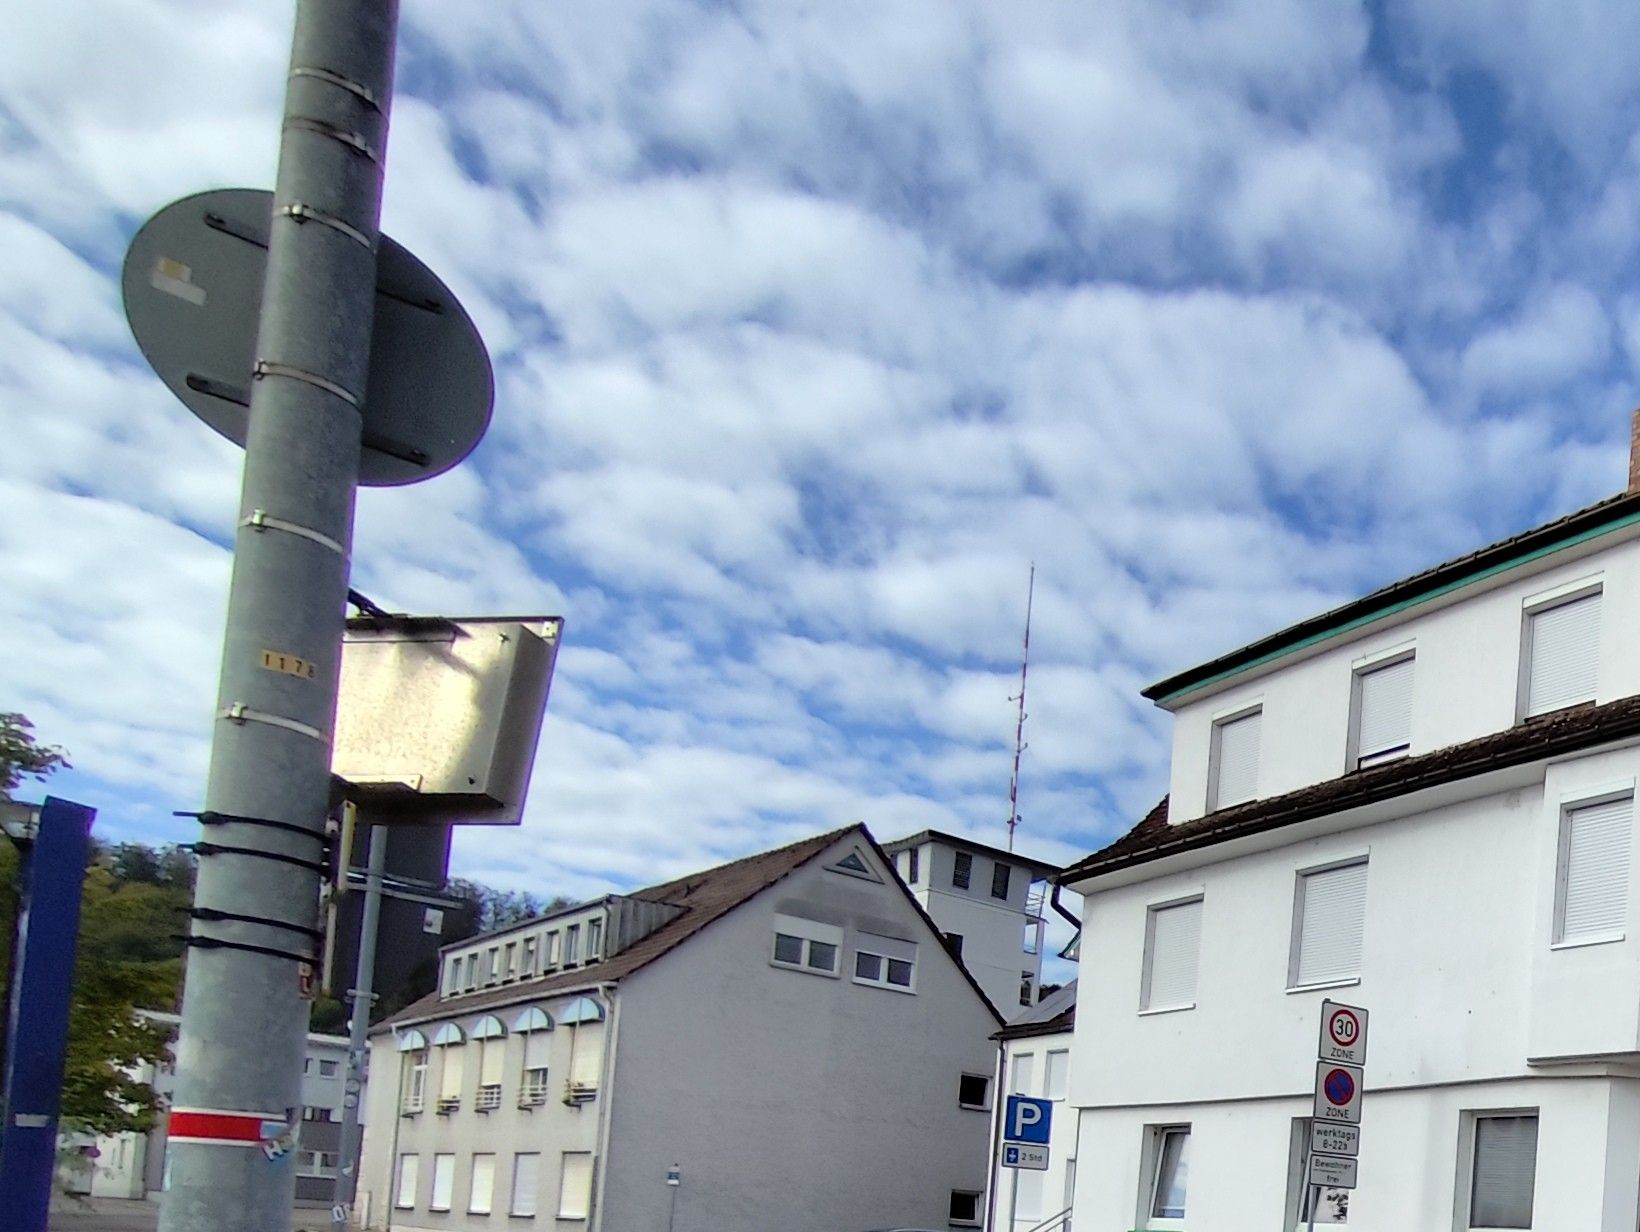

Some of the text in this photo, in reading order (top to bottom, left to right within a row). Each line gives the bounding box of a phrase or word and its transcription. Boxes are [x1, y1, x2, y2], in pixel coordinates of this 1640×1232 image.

[1335, 1018, 1354, 1038] 30
[1330, 1047, 1355, 1060] ZONE
[1014, 1101, 1042, 1137] P
[1326, 1106, 1350, 1119] ZONE
[1316, 1129, 1356, 1142] werktags
[1021, 1152, 1027, 1161] 2
